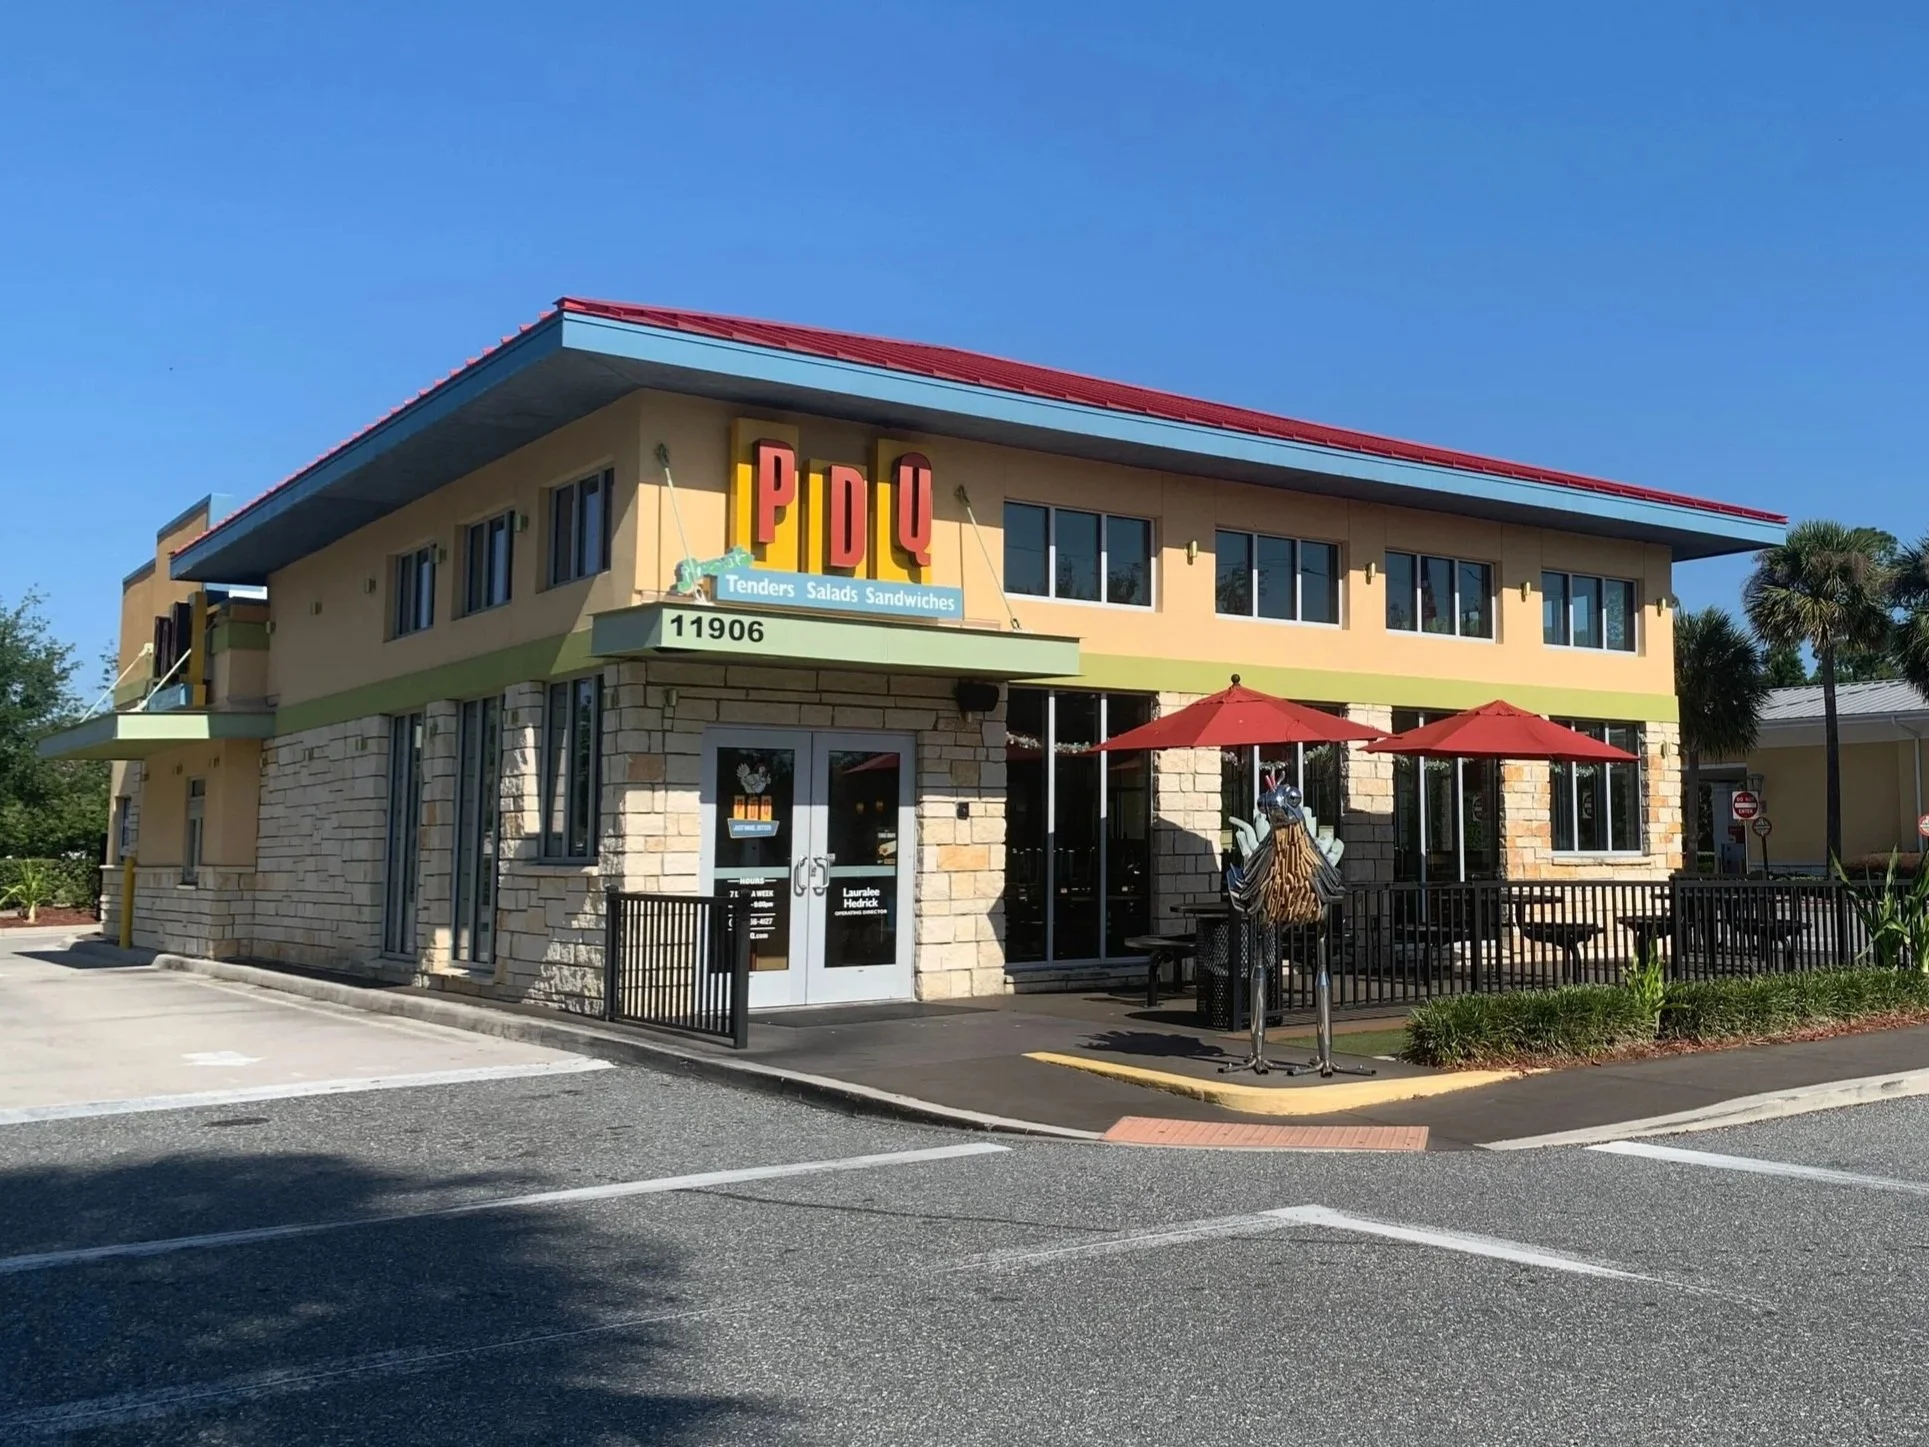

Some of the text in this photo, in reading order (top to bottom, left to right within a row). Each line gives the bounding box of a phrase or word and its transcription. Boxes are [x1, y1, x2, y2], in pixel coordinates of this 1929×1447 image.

[755, 438, 932, 568] PDQ
[725, 574, 955, 612] Tenders Salads Sandwiches
[670, 614, 764, 643] 11906
[756, 889, 774, 897] WEEK
[843, 887, 880, 897] Lauralee
[843, 897, 879, 908] Hedrick
